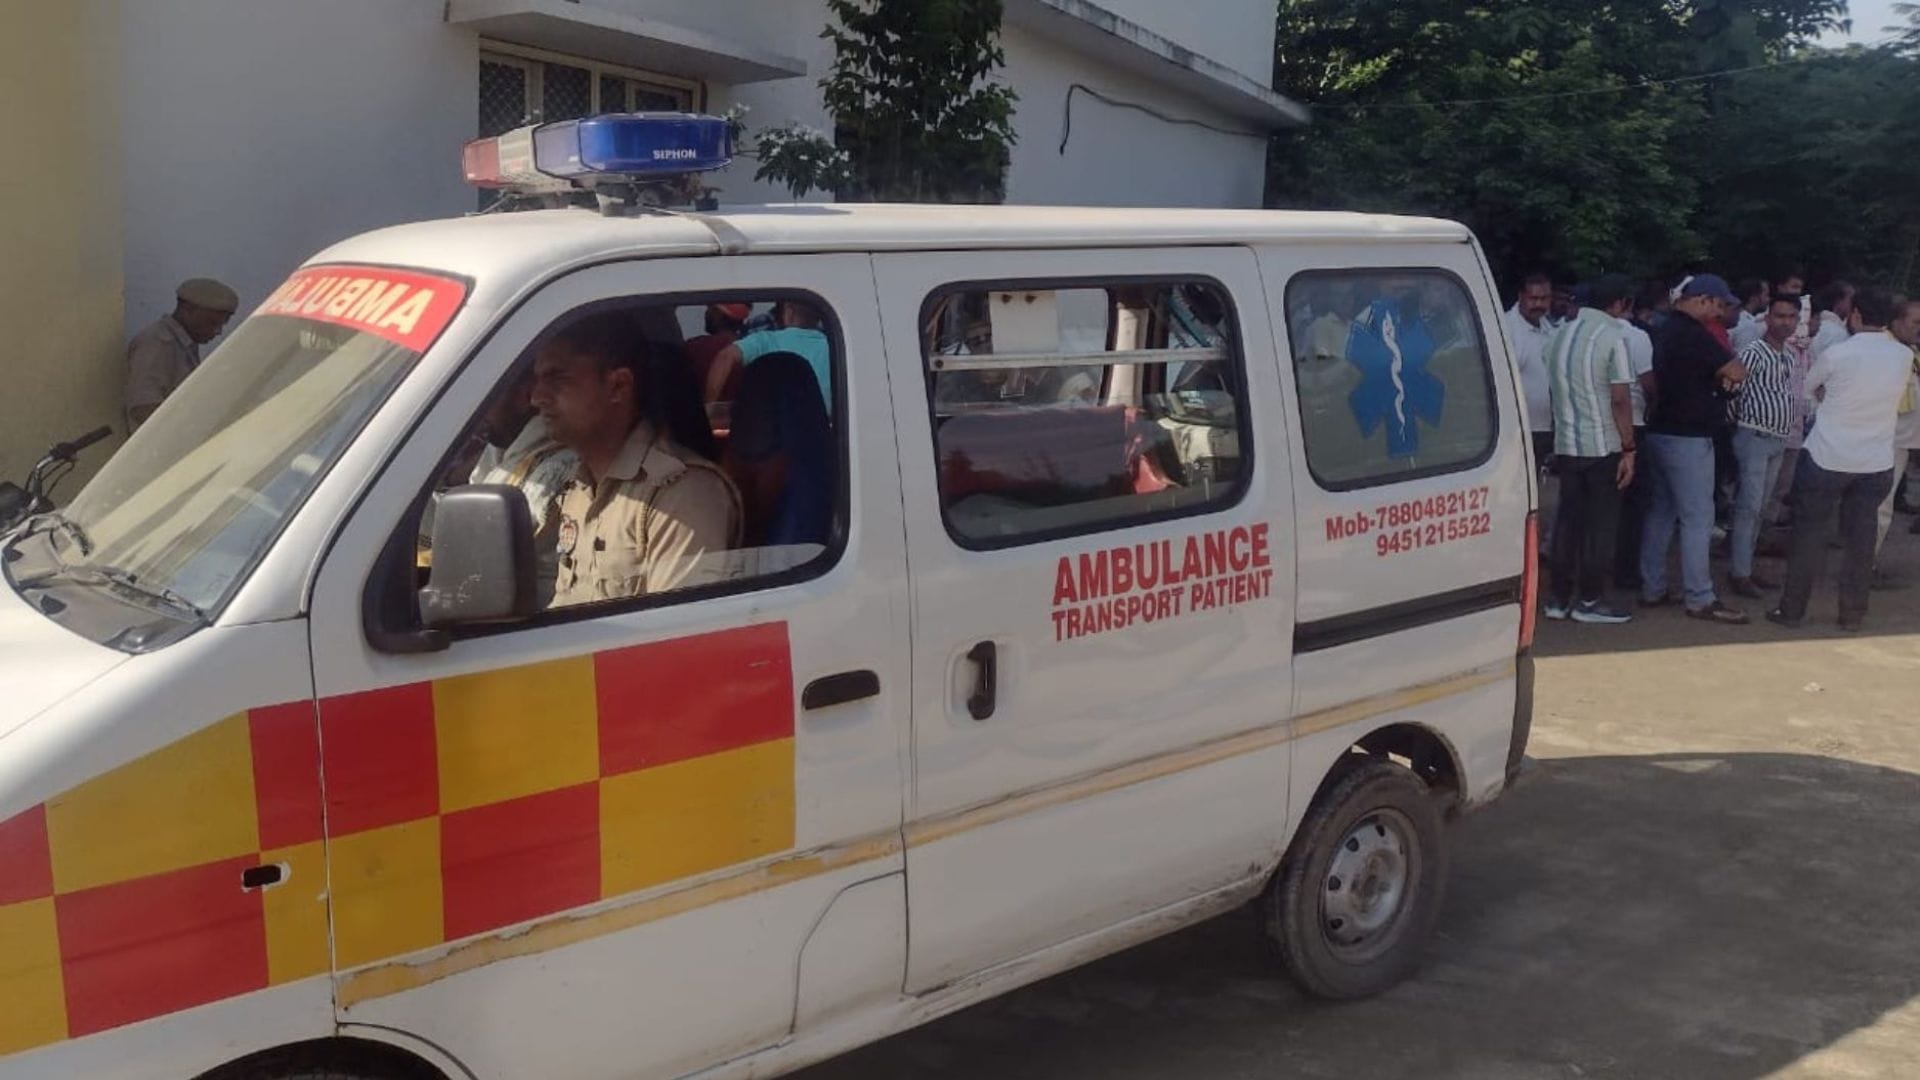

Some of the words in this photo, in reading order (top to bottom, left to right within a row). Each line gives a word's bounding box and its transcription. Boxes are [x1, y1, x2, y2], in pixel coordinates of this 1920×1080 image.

[652, 149, 697, 160] SIPHON
[1325, 486, 1489, 541] Mob-7880482127
[1376, 512, 1491, 556] 9451215522
[1053, 523, 1270, 606] AMBULANCE
[1052, 586, 1185, 642] TRANSPORT
[1190, 569, 1273, 612] PATIENT
